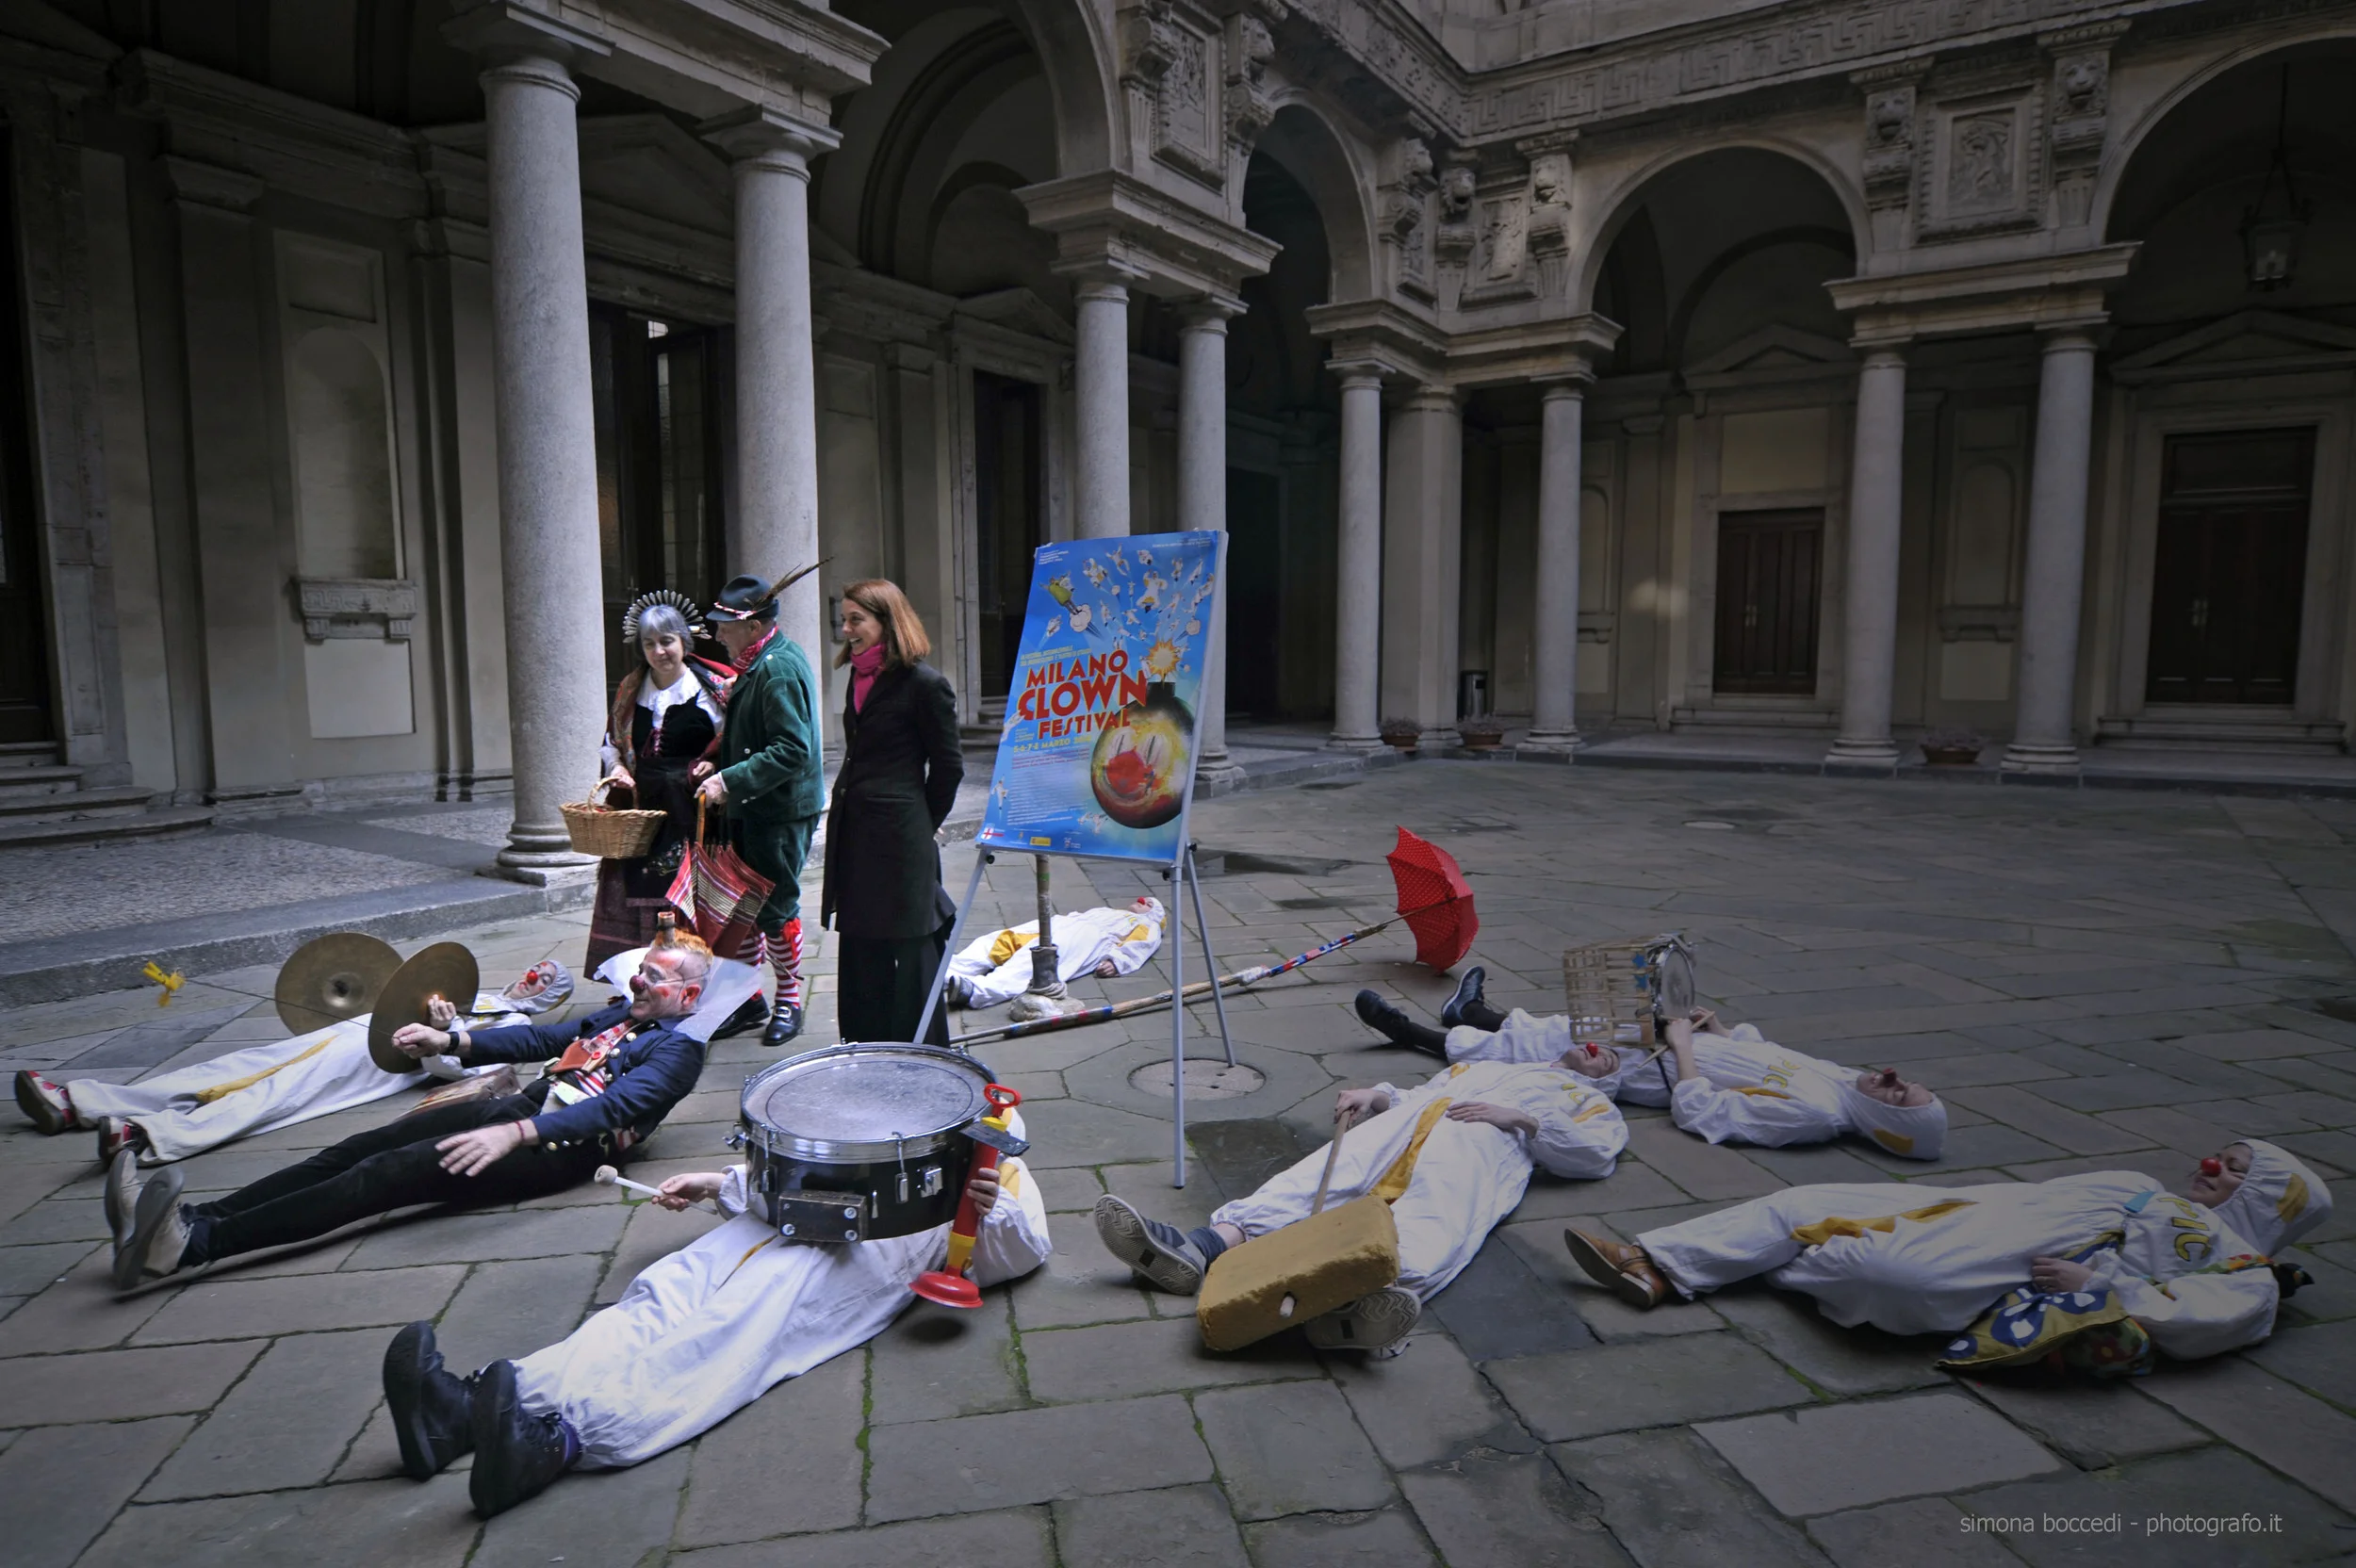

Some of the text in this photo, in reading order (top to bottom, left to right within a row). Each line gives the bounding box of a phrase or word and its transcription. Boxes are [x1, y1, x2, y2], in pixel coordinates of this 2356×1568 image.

[1025, 648, 1129, 689] MILANO
[1017, 670, 1147, 721] CLOWN
[1038, 710, 1131, 740] FESTIVAL
[1041, 737, 1072, 749] MARZO
